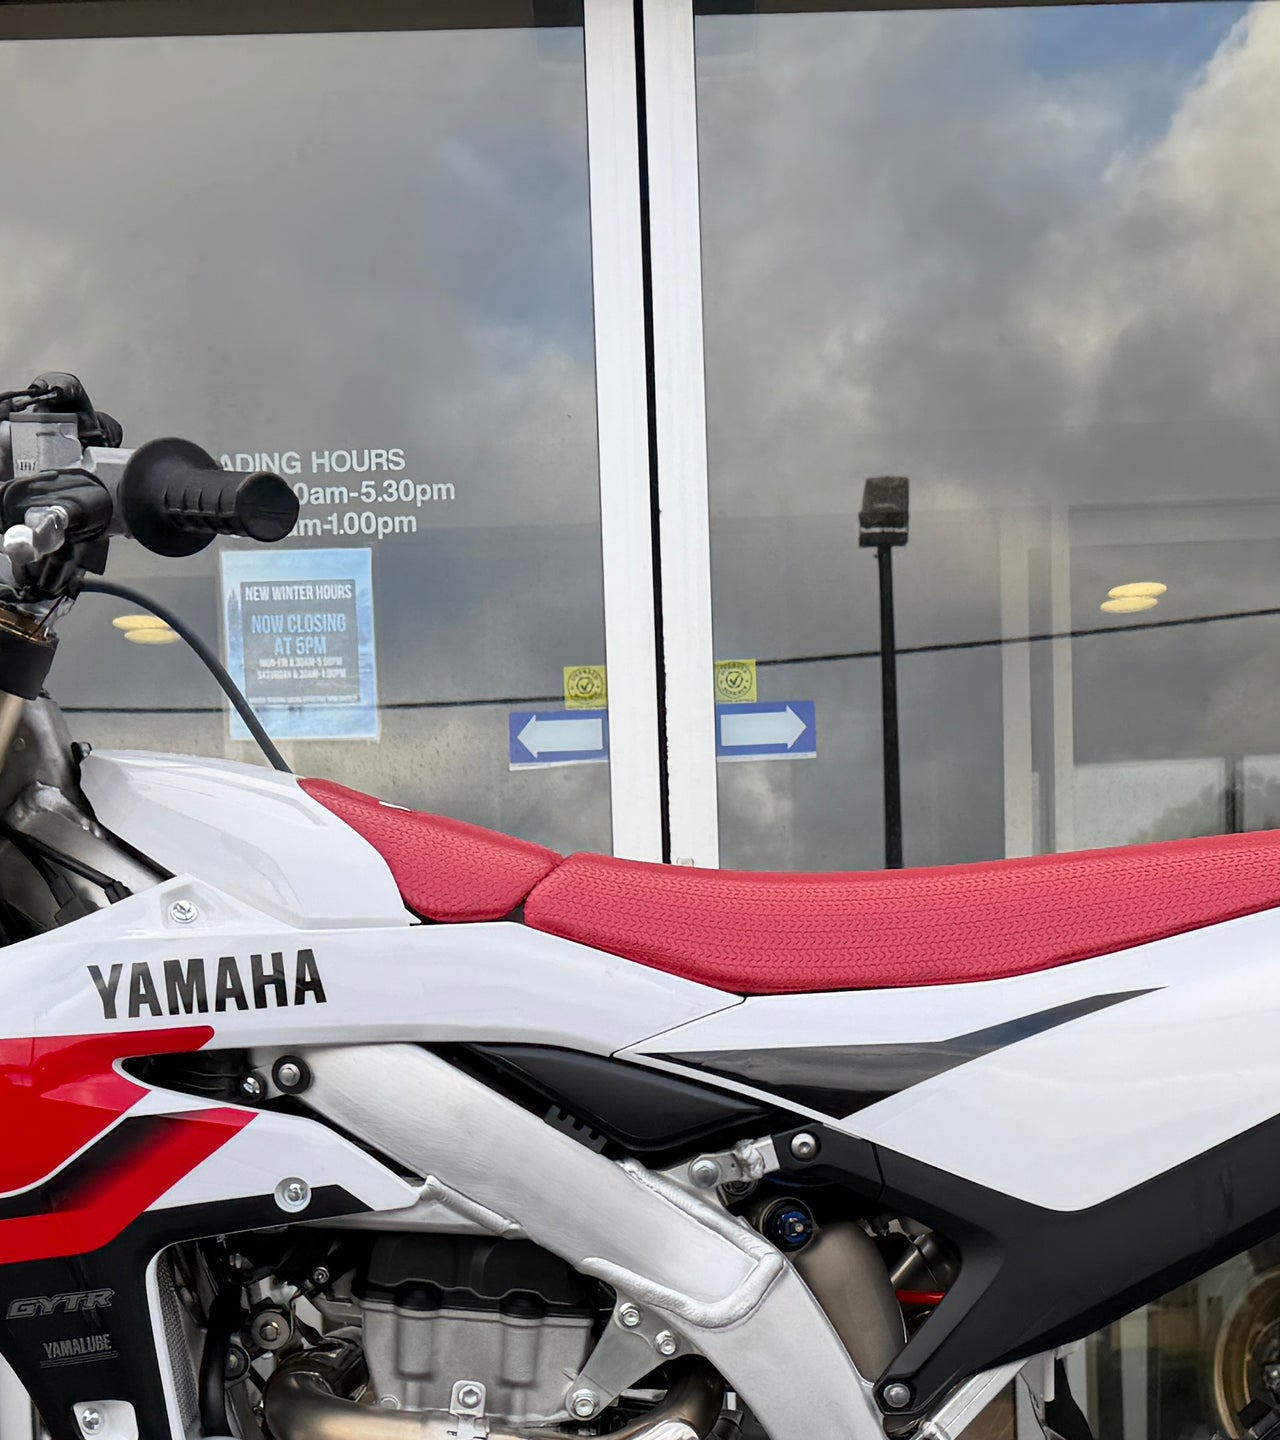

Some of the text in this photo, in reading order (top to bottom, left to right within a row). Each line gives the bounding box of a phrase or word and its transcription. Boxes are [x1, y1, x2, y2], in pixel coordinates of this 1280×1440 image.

[312, 448, 406, 473] HOURS
[245, 584, 352, 601] NEW WINTER HOURS
[251, 613, 346, 633] NOW CLOSING
[274, 636, 327, 655] AT 5PM
[87, 948, 327, 1019] YAMAHA
[6, 1288, 115, 1319] GYTR
[42, 1334, 112, 1359] YAMALUBE
